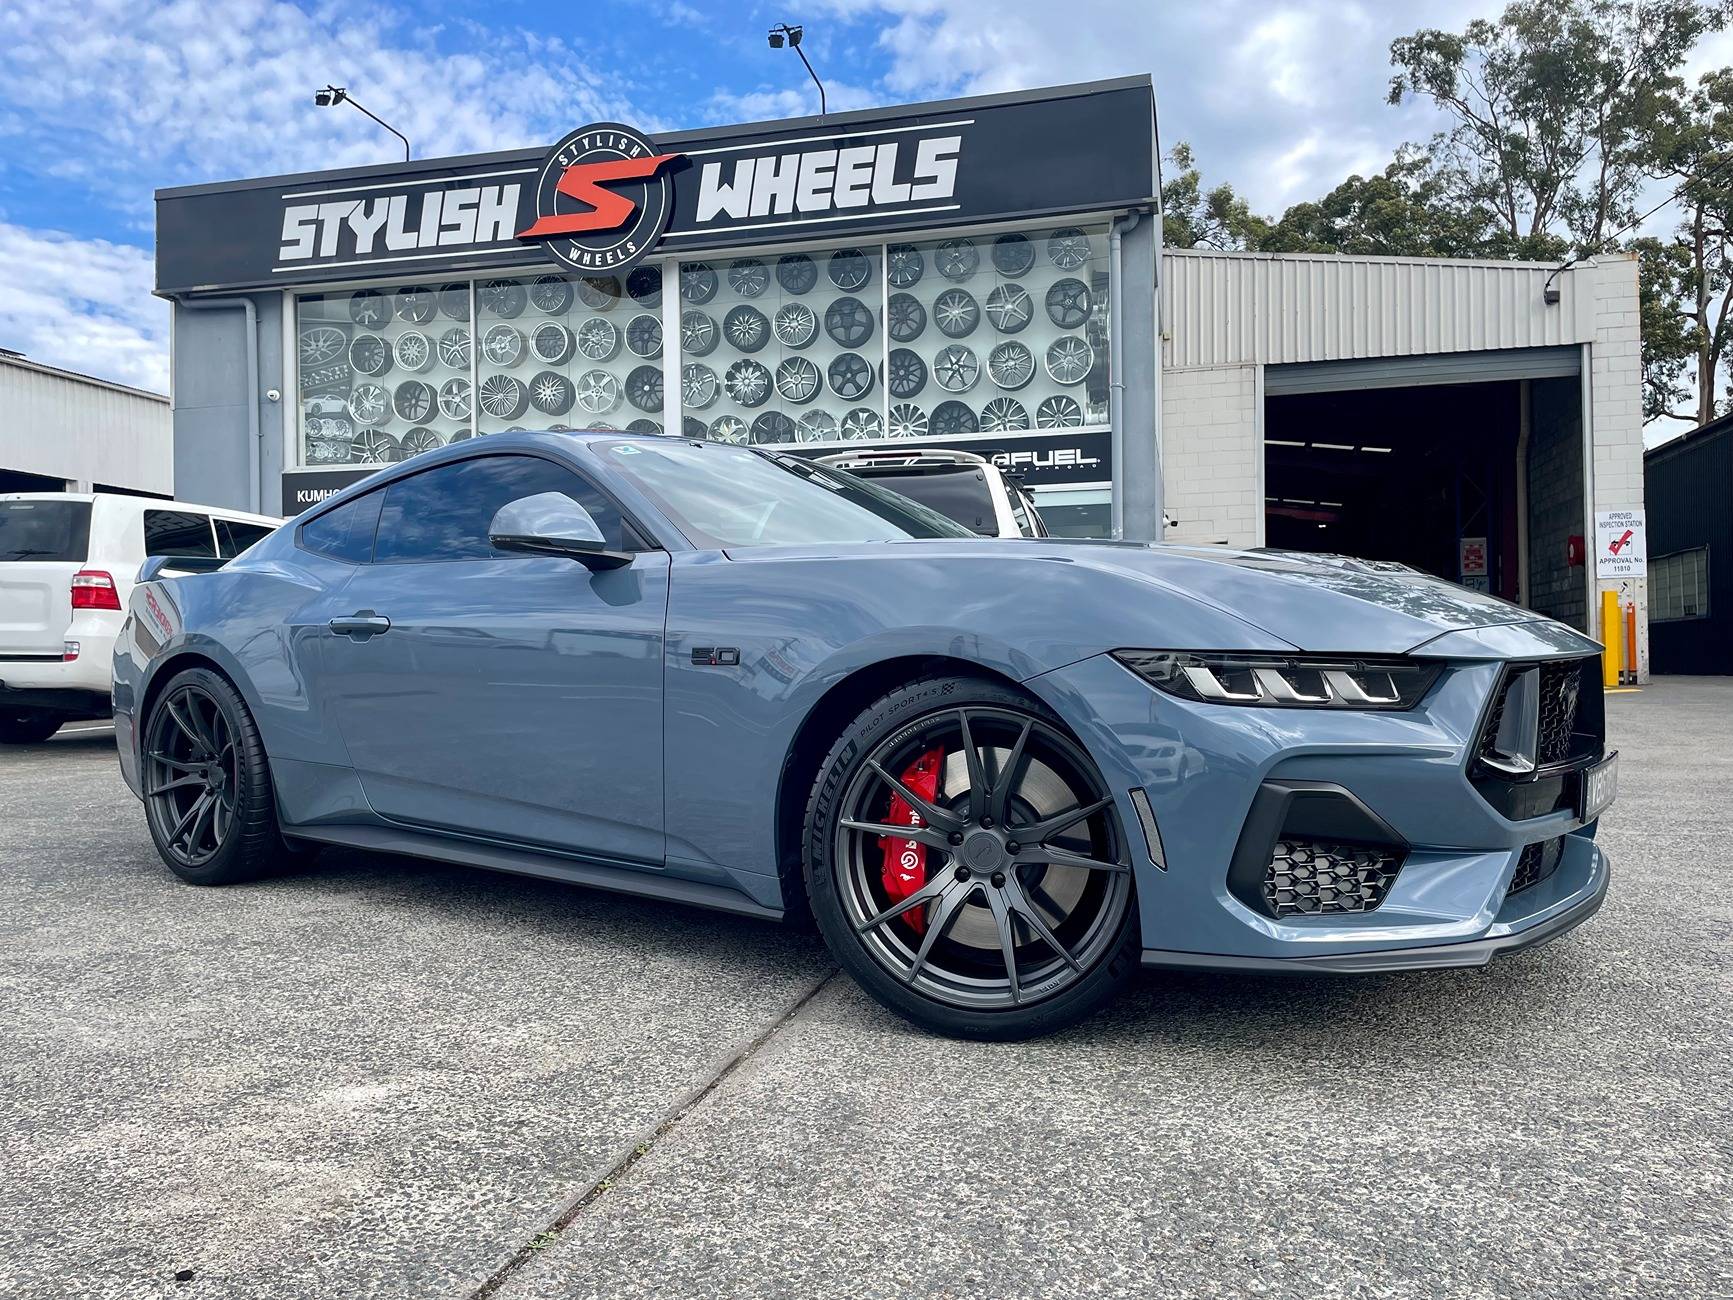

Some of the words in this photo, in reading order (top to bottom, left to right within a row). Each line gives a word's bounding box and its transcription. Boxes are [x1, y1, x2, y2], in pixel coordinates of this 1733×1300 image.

[558, 135, 642, 166] STYLISH
[279, 184, 521, 261] STYLISH
[696, 136, 962, 222] WHEELS
[569, 241, 636, 266] WHEELS
[1599, 521, 1624, 529] INSPECTION
[1625, 520, 1643, 528] STATION
[1608, 512, 1633, 520] APPROVED
[860, 713, 885, 737] PILOT
[811, 744, 854, 858] MICHELIN
